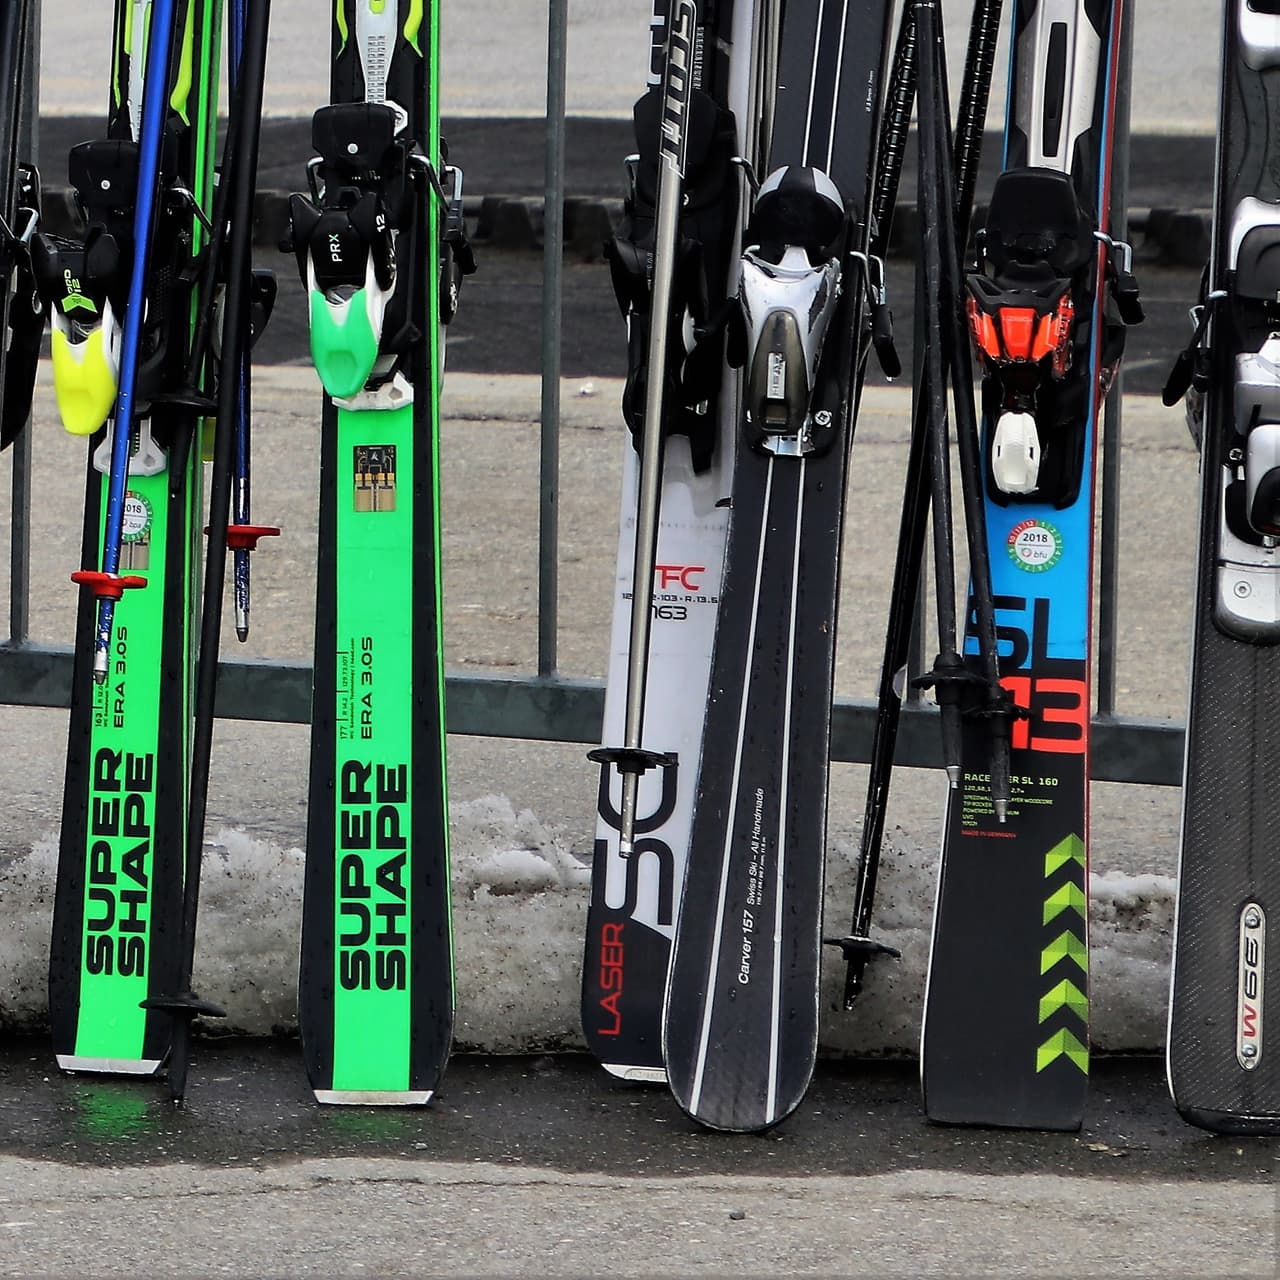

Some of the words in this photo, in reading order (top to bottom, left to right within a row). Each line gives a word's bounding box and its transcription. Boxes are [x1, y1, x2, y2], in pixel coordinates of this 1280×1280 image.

[1023, 532, 1049, 544] 2018
[114, 627, 129, 678] 3.0S
[964, 594, 1087, 670] SL
[360, 637, 374, 689] 3.0S
[113, 683, 126, 730] ERA
[360, 694, 373, 740] ERA
[1021, 776, 1034, 785] SL
[1038, 777, 1059, 787] 160
[752, 786, 766, 840] Handmade
[86, 747, 124, 977] SUPER
[116, 753, 154, 979] SHAPE
[339, 759, 373, 992] SUPER
[375, 763, 409, 992] SHAPE
[747, 879, 758, 907] Swiss
[742, 910, 755, 936] 157
[598, 922, 625, 1037] LASER
[738, 938, 753, 986] Carver
